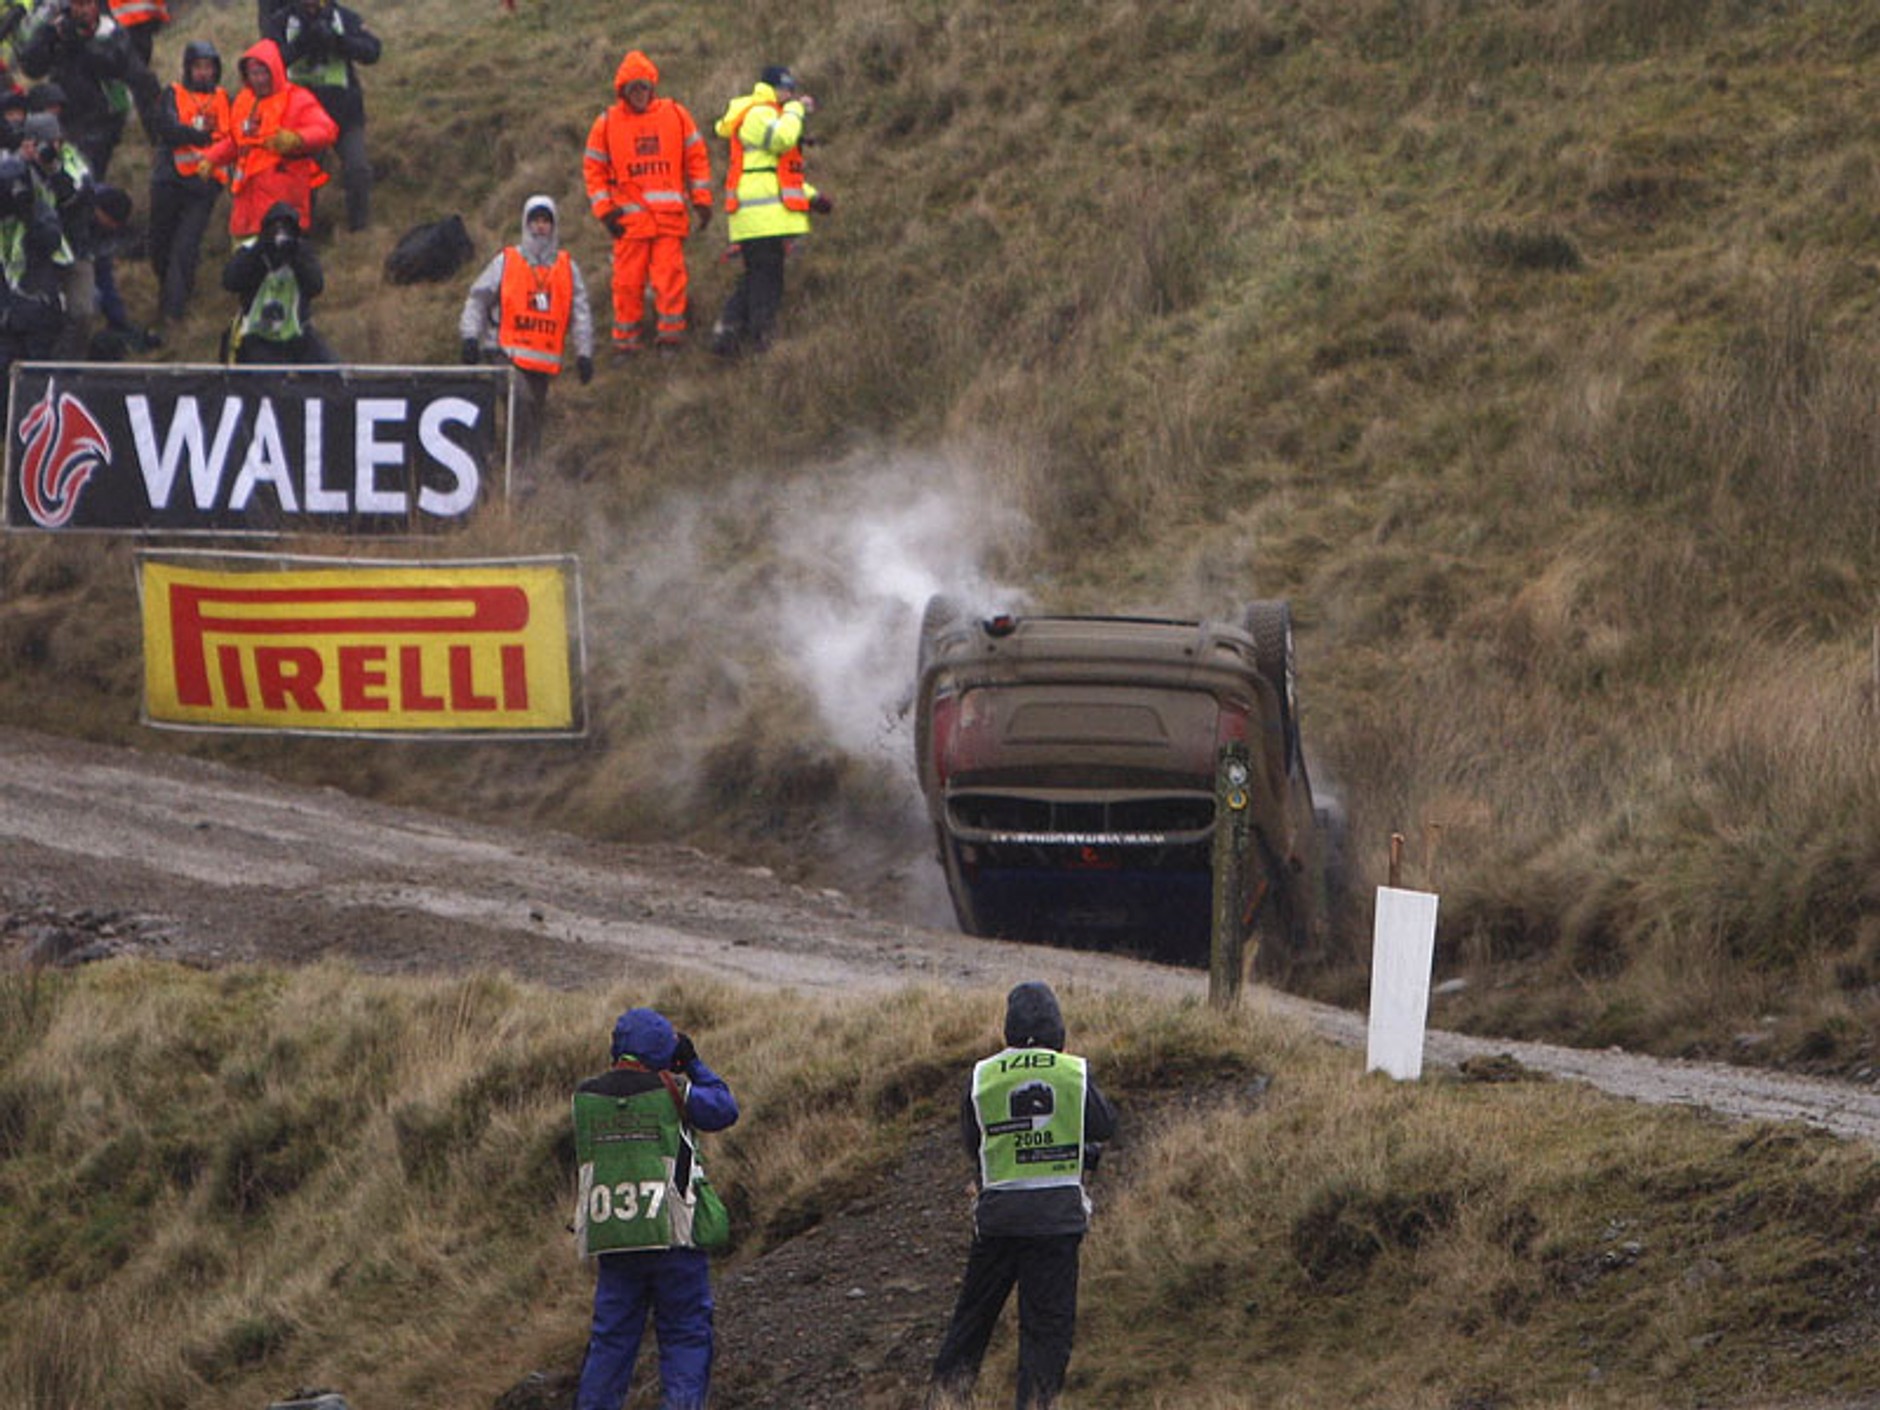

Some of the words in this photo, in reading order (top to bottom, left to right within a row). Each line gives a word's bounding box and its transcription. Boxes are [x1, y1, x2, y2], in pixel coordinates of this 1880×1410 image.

[627, 161, 671, 177] SAFETY
[514, 315, 557, 336] SAFETY
[125, 395, 481, 517] WALES
[169, 582, 530, 712] PIRELLI
[1013, 1131, 1054, 1147] 2008
[590, 1181, 666, 1223] 037
